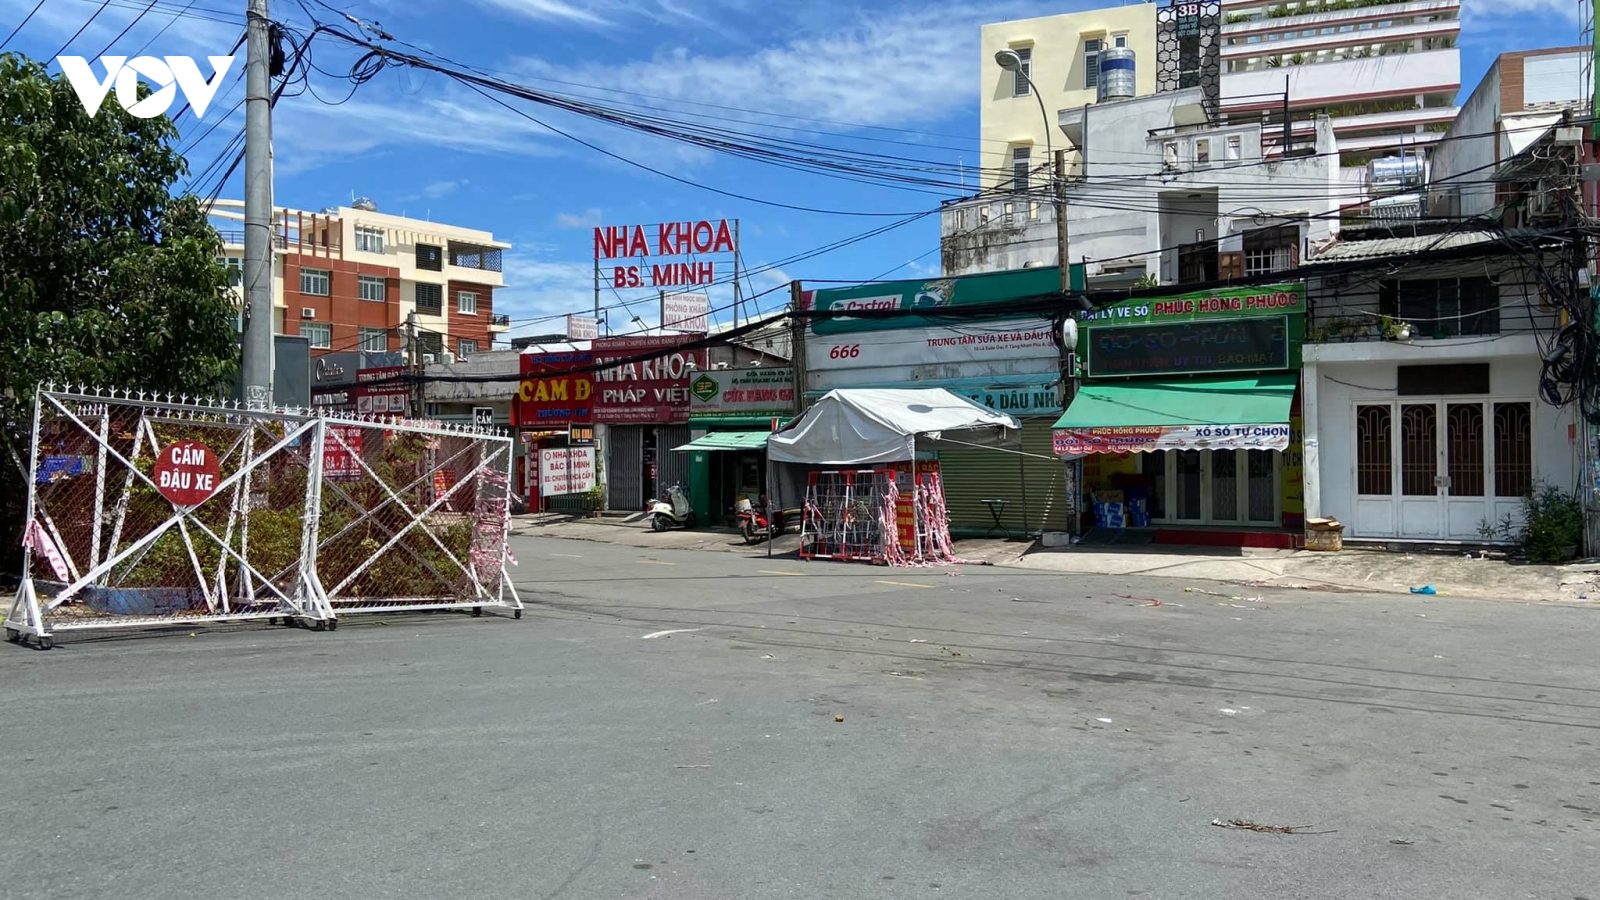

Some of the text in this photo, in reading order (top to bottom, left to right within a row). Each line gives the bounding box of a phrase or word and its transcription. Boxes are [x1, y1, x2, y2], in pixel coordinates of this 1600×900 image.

[1178, 4, 1198, 17] 3B
[594, 218, 735, 259] NHA KHOA
[614, 261, 714, 288] BS. MINH
[1101, 306, 1114, 319] LÝ
[1117, 304, 1131, 318] VÉ
[1134, 301, 1150, 317] SỐ
[1154, 297, 1195, 316] PHÚC
[1199, 293, 1243, 313] HỒNG
[1246, 290, 1299, 309] PHƯỚC
[927, 337, 956, 347] TRUNG
[958, 334, 976, 345] TÂM
[997, 333, 1008, 342] XE
[829, 343, 860, 360] 666
[643, 352, 697, 380] KHOA
[603, 383, 689, 405] PHÁP VIỆT
[696, 381, 713, 391] SP
[985, 394, 995, 410] &
[1092, 427, 1112, 435] PHÚC
[1135, 425, 1160, 434] PHƯỚC
[1234, 426, 1251, 439] TỰ
[1254, 426, 1288, 439] CHỌN
[171, 443, 205, 466] CẤM
[552, 450, 588, 460] NHA KHOA
[550, 460, 565, 471] BÁC
[574, 460, 590, 470] MINH
[160, 468, 213, 493] ĐẬU XE
